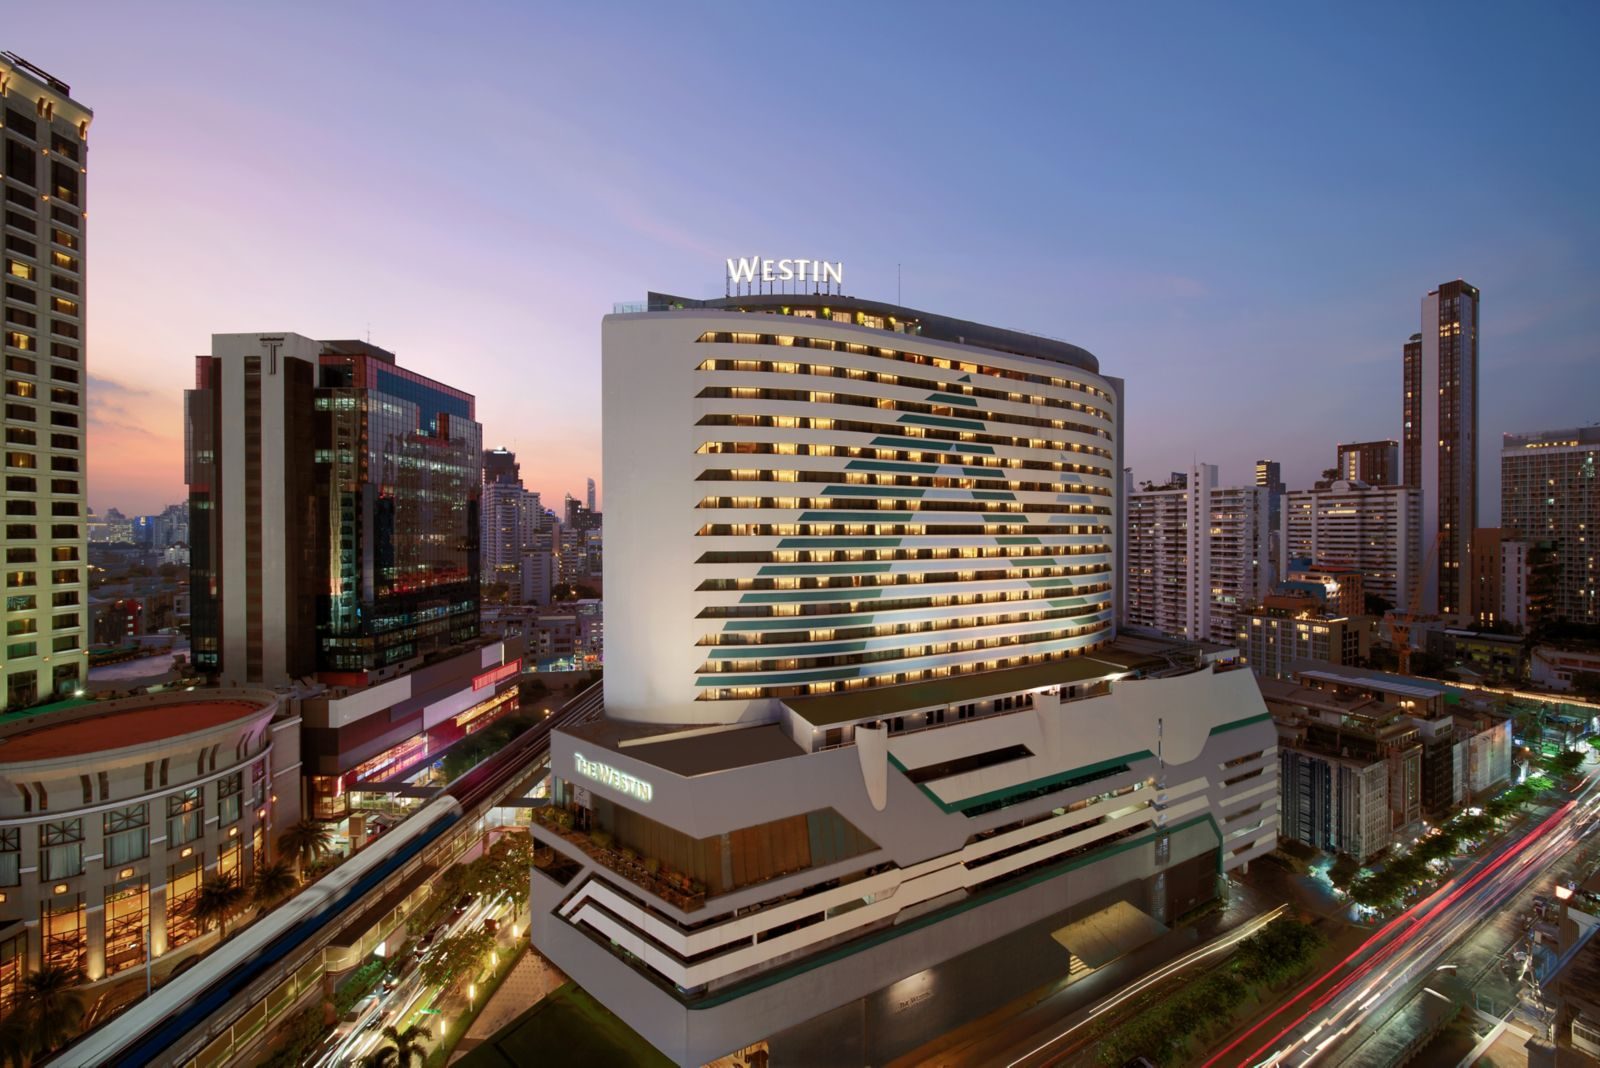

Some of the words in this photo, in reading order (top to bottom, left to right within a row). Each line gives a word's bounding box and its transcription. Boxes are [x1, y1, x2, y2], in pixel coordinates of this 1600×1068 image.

[727, 256, 842, 283] WESTIN
[574, 752, 597, 779] THE
[598, 763, 652, 801] WESTIN
